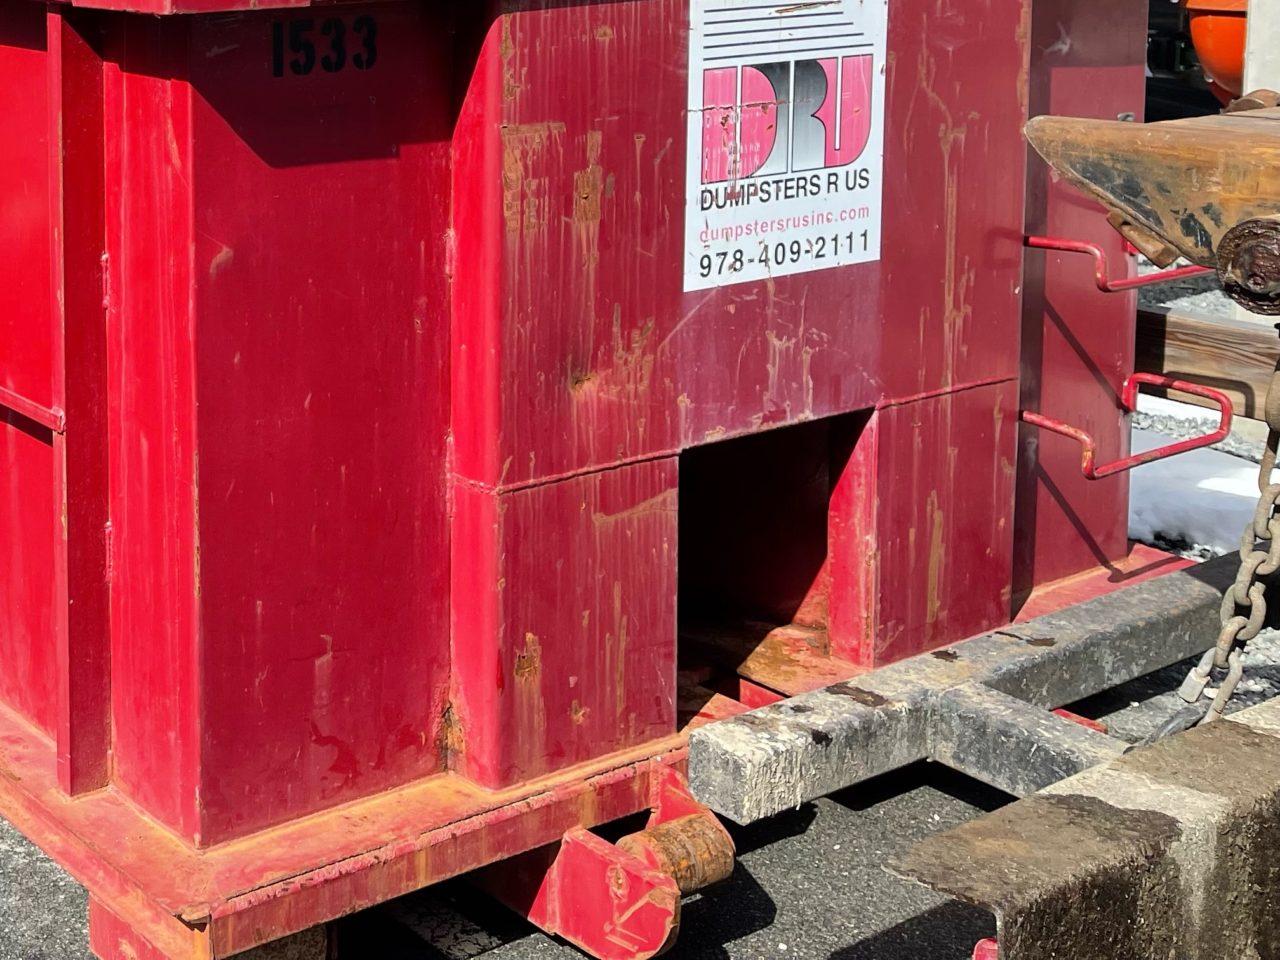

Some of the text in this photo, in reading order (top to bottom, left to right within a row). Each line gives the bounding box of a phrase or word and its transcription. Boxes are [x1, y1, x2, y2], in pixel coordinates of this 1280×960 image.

[272, 14, 377, 78] 1533
[700, 168, 870, 212] DUMPSTERS R US
[699, 205, 870, 242] dumpstersrusinc.com
[699, 228, 868, 278] 978-409-2111
